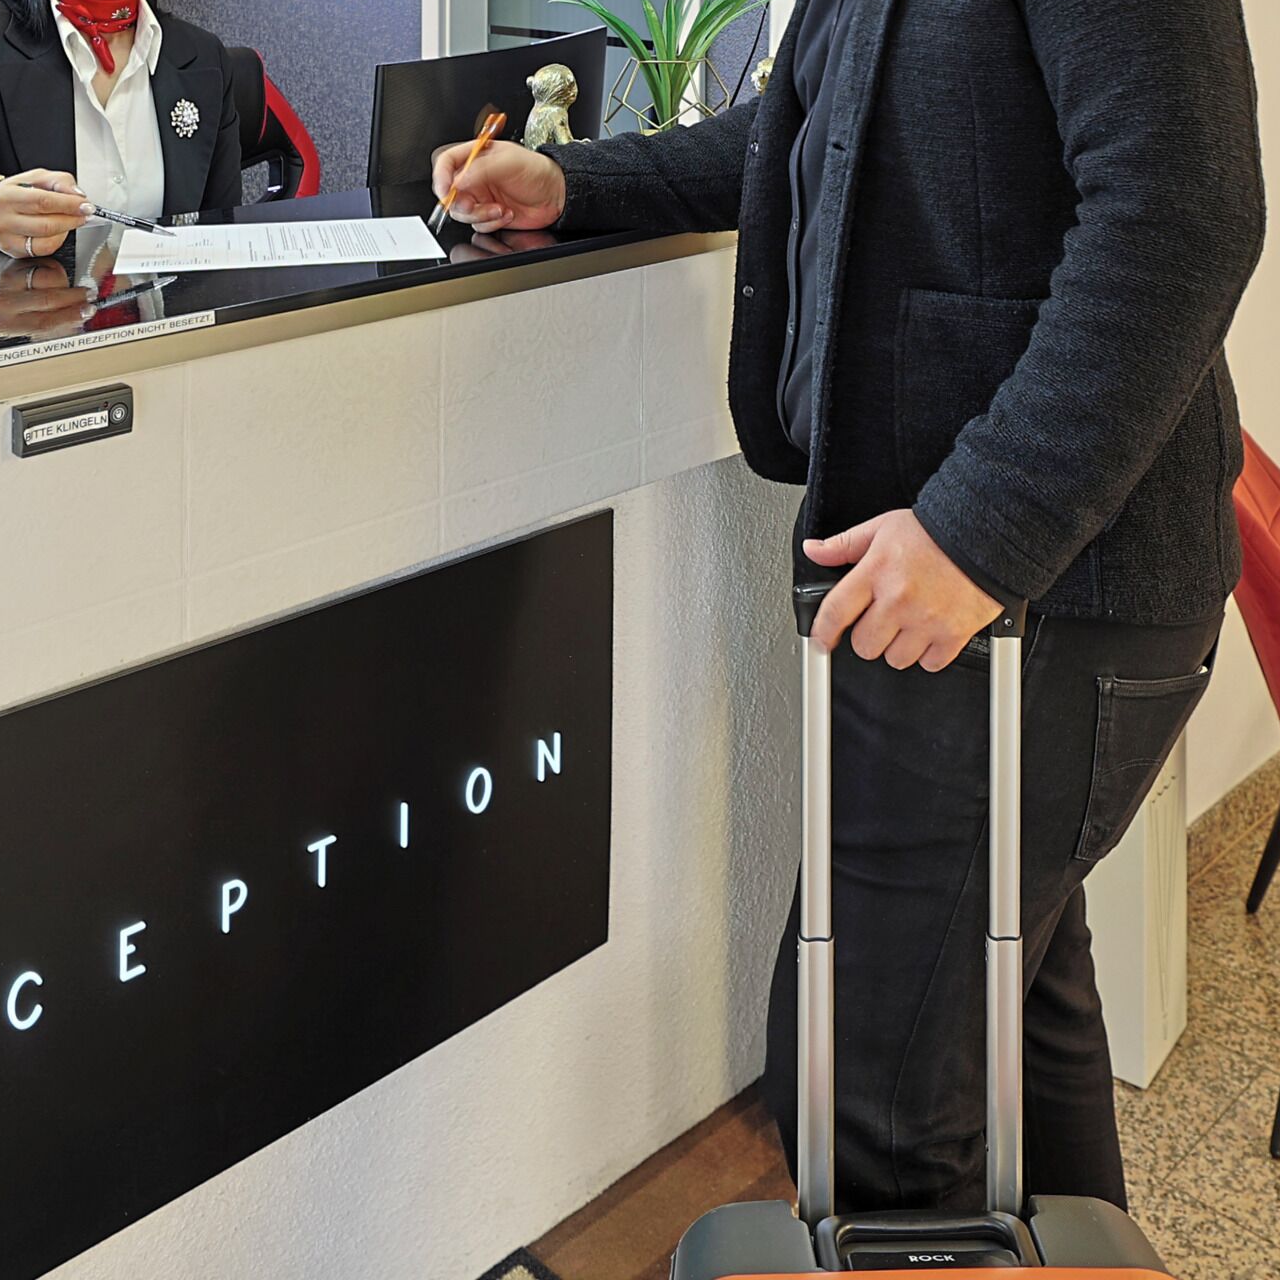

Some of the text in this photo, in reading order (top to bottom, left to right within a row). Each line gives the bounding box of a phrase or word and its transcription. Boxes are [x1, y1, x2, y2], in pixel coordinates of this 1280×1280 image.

[78, 329, 135, 347] REZEPTION
[137, 323, 166, 336] NICHT
[25, 414, 108, 442] BITTE KLINGELN
[908, 1254, 956, 1262] ROCK
